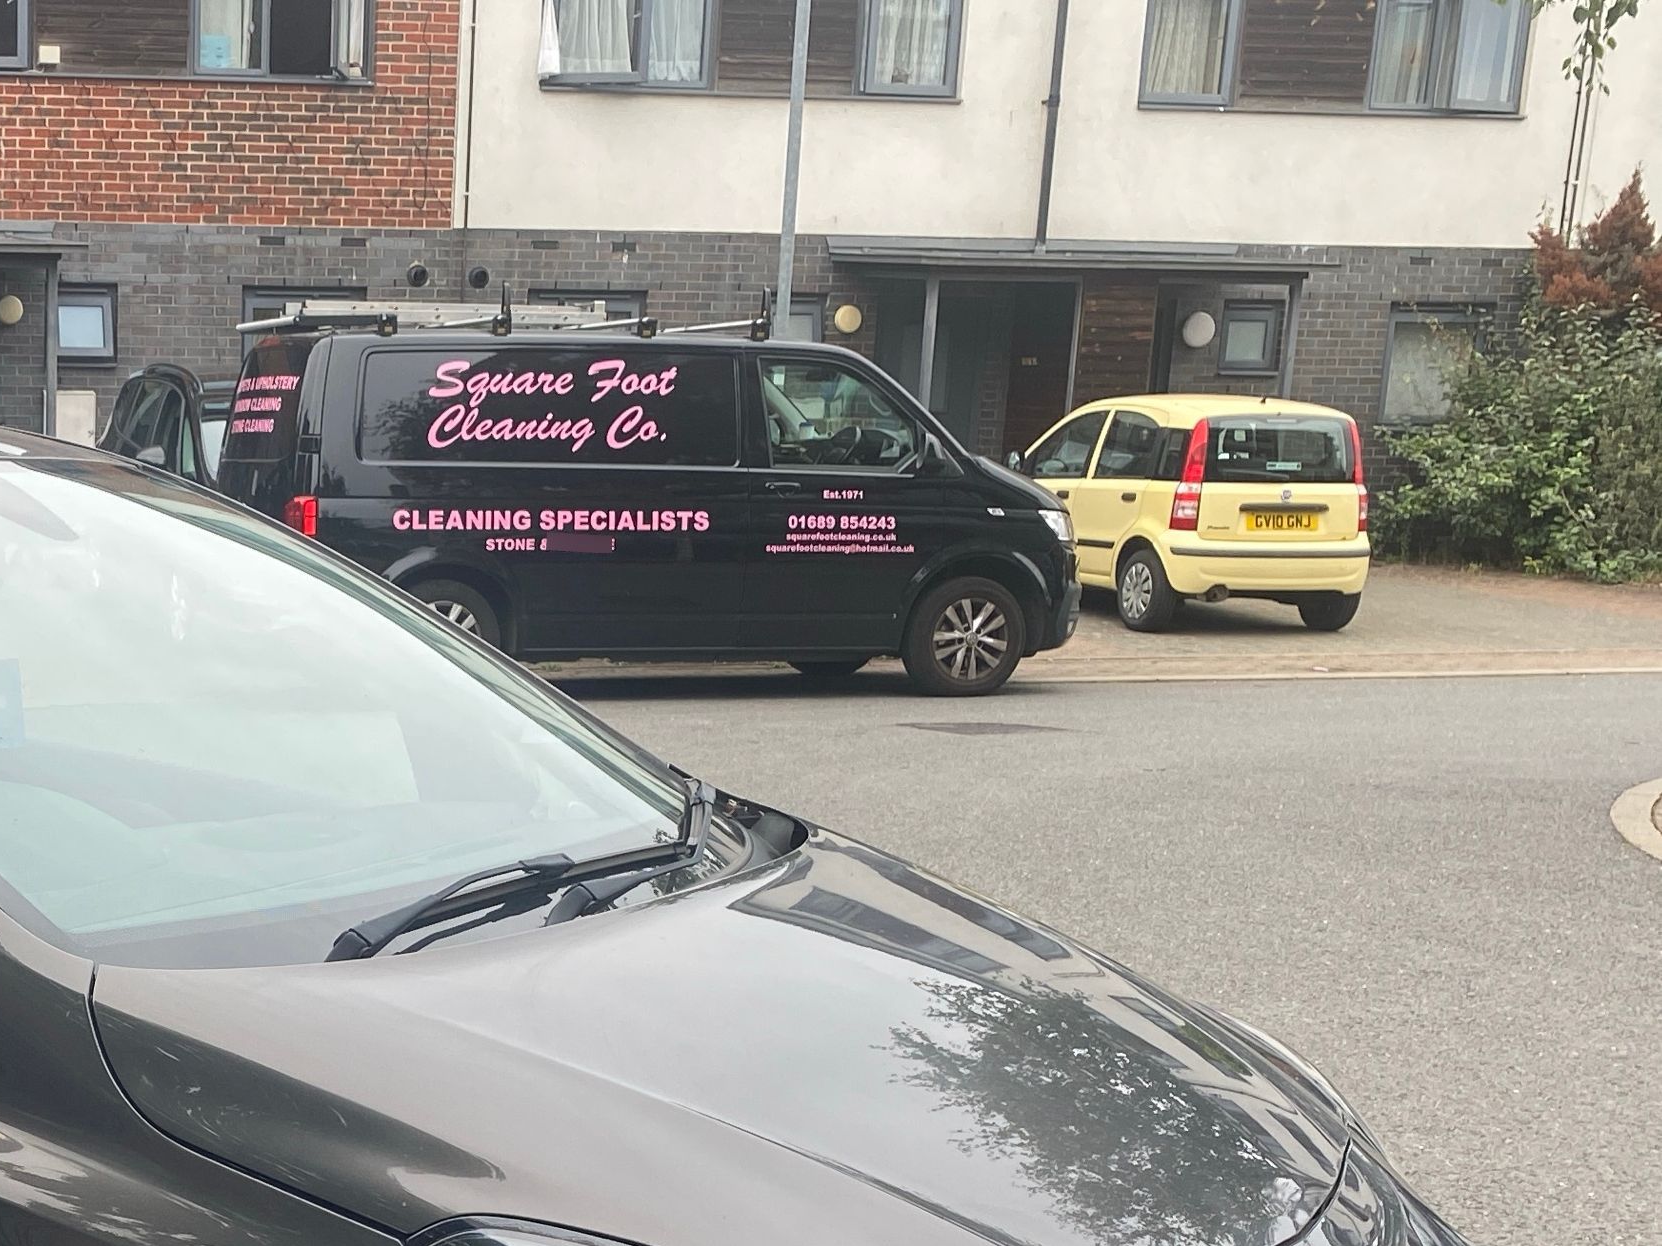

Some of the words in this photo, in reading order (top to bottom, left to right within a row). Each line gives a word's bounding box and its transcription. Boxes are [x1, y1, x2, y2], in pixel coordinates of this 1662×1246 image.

[256, 375, 300, 391] UPHOLSTERY
[429, 360, 574, 407] Square
[588, 360, 677, 402] Foot
[251, 396, 282, 412] CLEANING
[245, 418, 274, 433] CLEANING
[427, 404, 595, 452] Cleaning
[606, 405, 667, 449] Co.
[823, 489, 864, 500] Est.1971
[392, 509, 532, 531] CLEANING
[539, 510, 710, 531] SPECIALISTS
[788, 514, 836, 530] 01689
[840, 515, 896, 530] 854243
[1255, 514, 1283, 529] GV10
[1287, 514, 1312, 529] GNJ
[485, 538, 536, 551] STONE
[786, 532, 897, 543] squarefootcleaning.co.uk
[765, 543, 915, 554] squarefootcleaning@hotmail.co.uk
